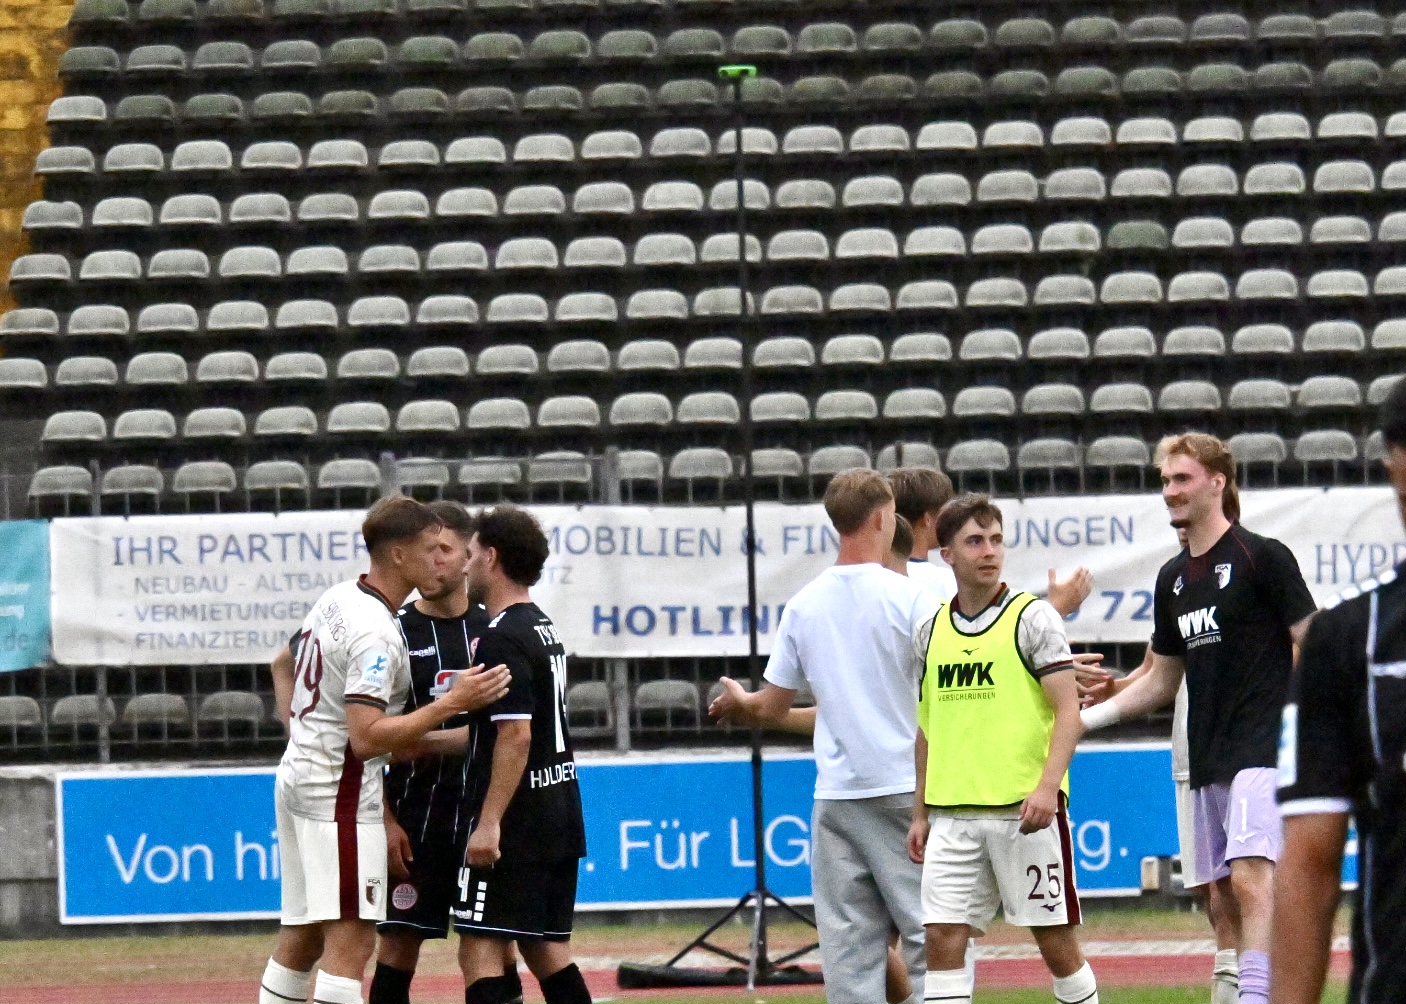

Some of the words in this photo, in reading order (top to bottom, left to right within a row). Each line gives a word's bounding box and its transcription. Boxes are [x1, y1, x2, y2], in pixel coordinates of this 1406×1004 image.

[113, 535, 181, 566] IHR
[550, 524, 721, 557] MOBILIEN
[134, 575, 228, 595] NEUBAU
[1177, 605, 1219, 639] WWK
[135, 631, 293, 650] FINANZIERUN
[937, 661, 995, 689] WWK
[937, 691, 996, 702] VERSICHERUNGEN
[105, 832, 214, 885] Von
[234, 830, 281, 881] hi
[619, 818, 710, 872] Für
[730, 814, 812, 867] LG
[1026, 862, 1062, 901] 25
